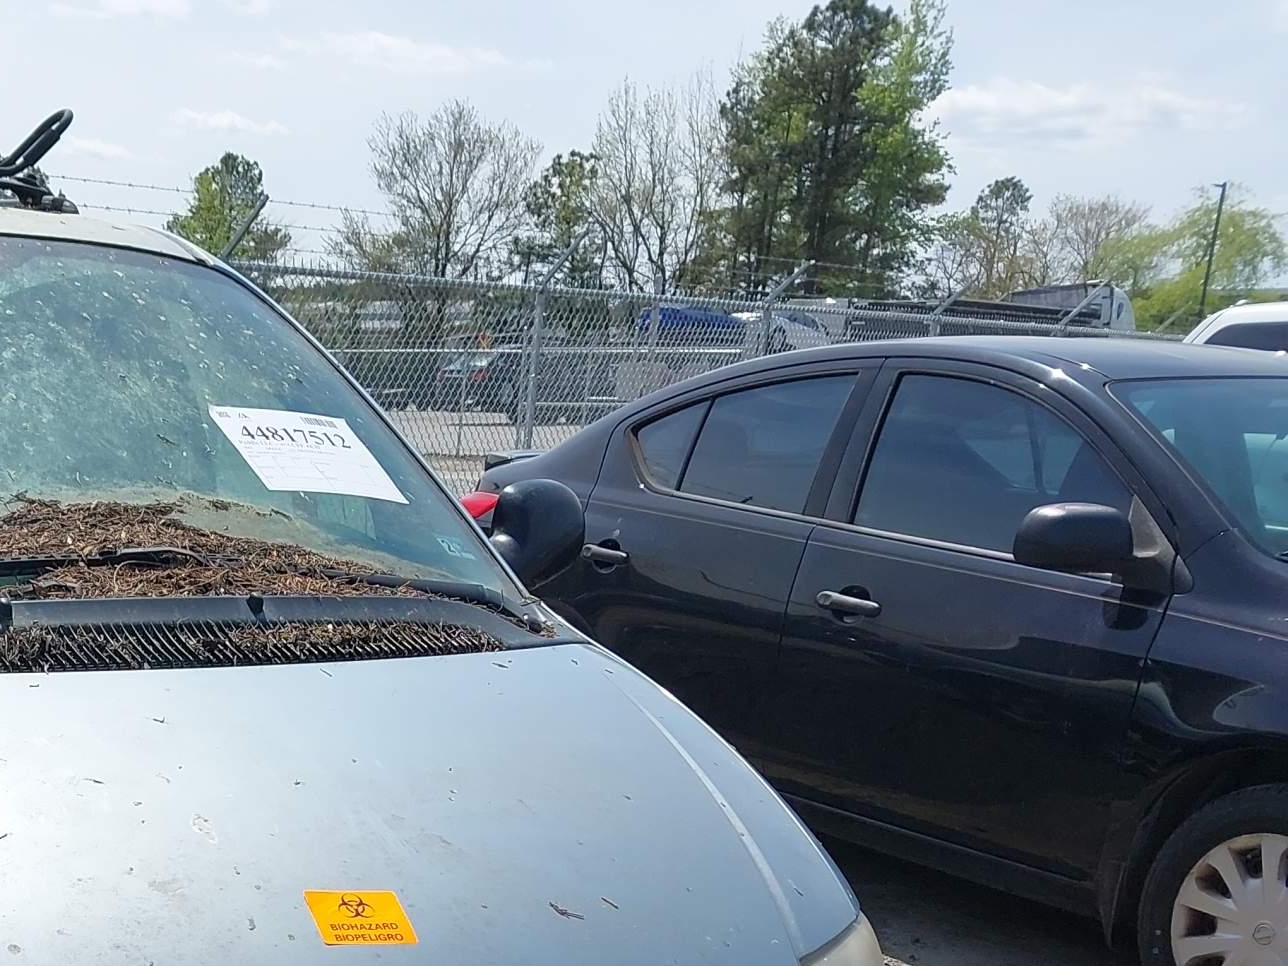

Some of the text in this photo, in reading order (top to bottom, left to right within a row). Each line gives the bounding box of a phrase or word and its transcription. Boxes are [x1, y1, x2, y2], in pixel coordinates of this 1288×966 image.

[241, 425, 352, 449] 44817512
[329, 922, 399, 931] BIOHAZARD
[334, 933, 404, 942] BIOPELIGRO
